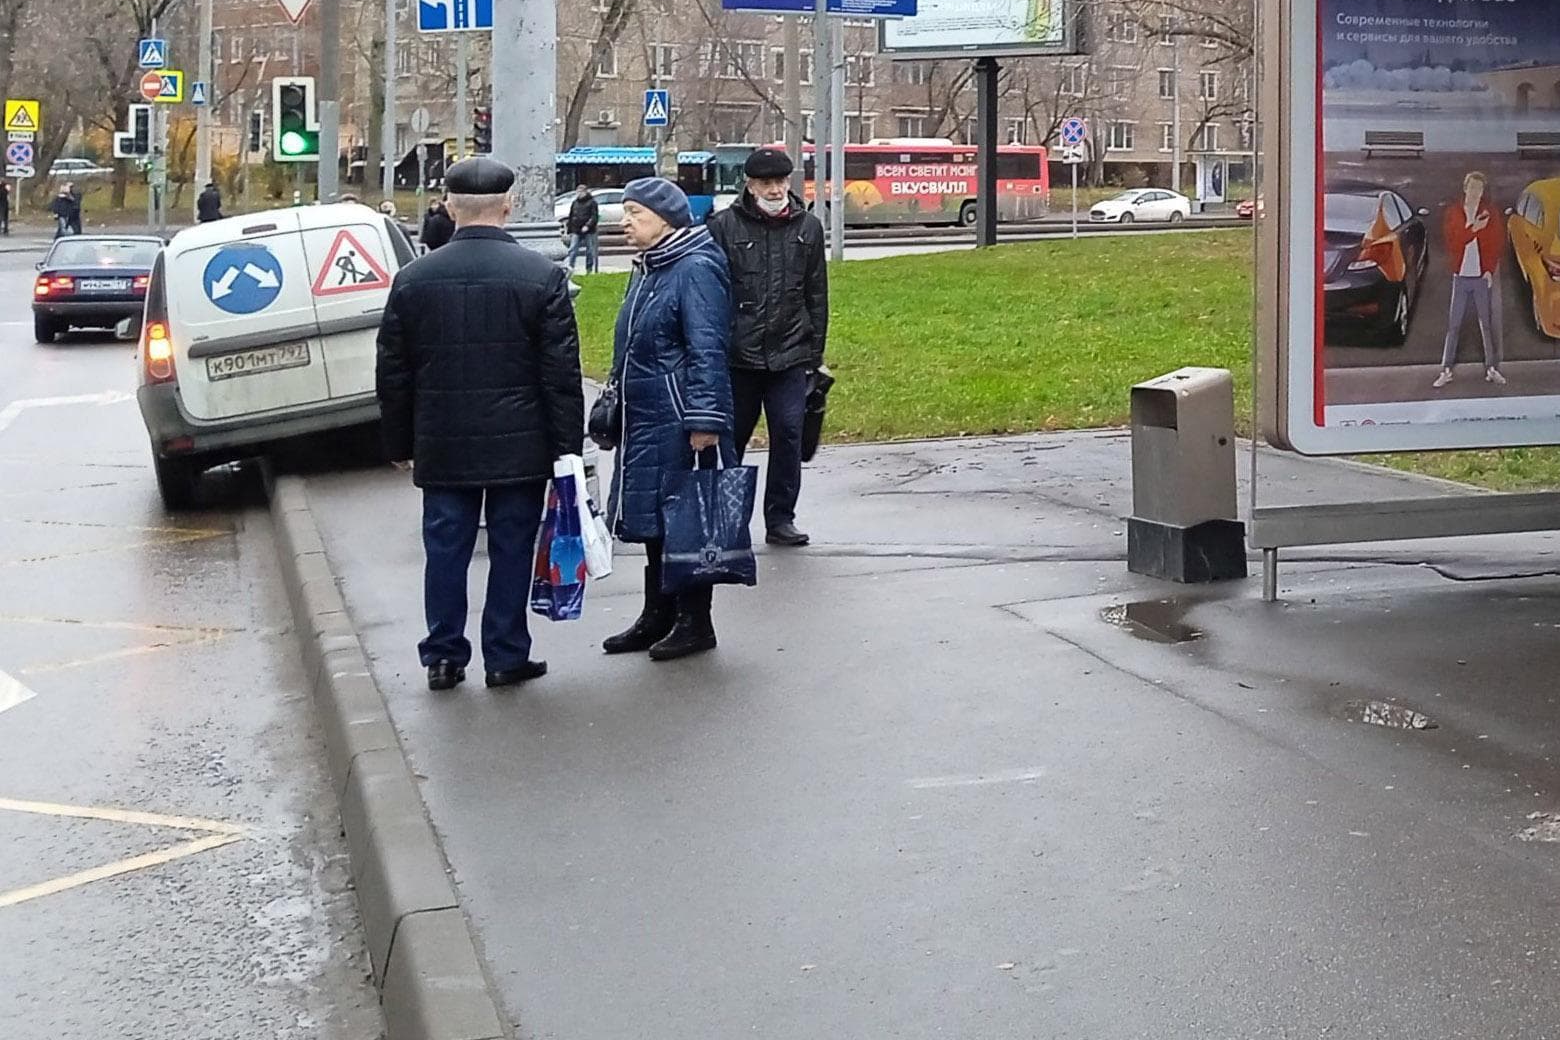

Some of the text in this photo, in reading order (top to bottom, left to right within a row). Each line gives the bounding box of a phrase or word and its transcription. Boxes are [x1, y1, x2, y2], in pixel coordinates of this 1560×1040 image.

[1336, 12, 1489, 30] Современные технологии
[1336, 32, 1345, 42] и
[1346, 32, 1398, 45] сервисы
[1399, 33, 1421, 45] для
[1466, 33, 1518, 48] удобства
[876, 164, 979, 177] ВСЕМ СВЕТИТ МАНГ
[890, 180, 968, 195] ВКУСВИЛЛ
